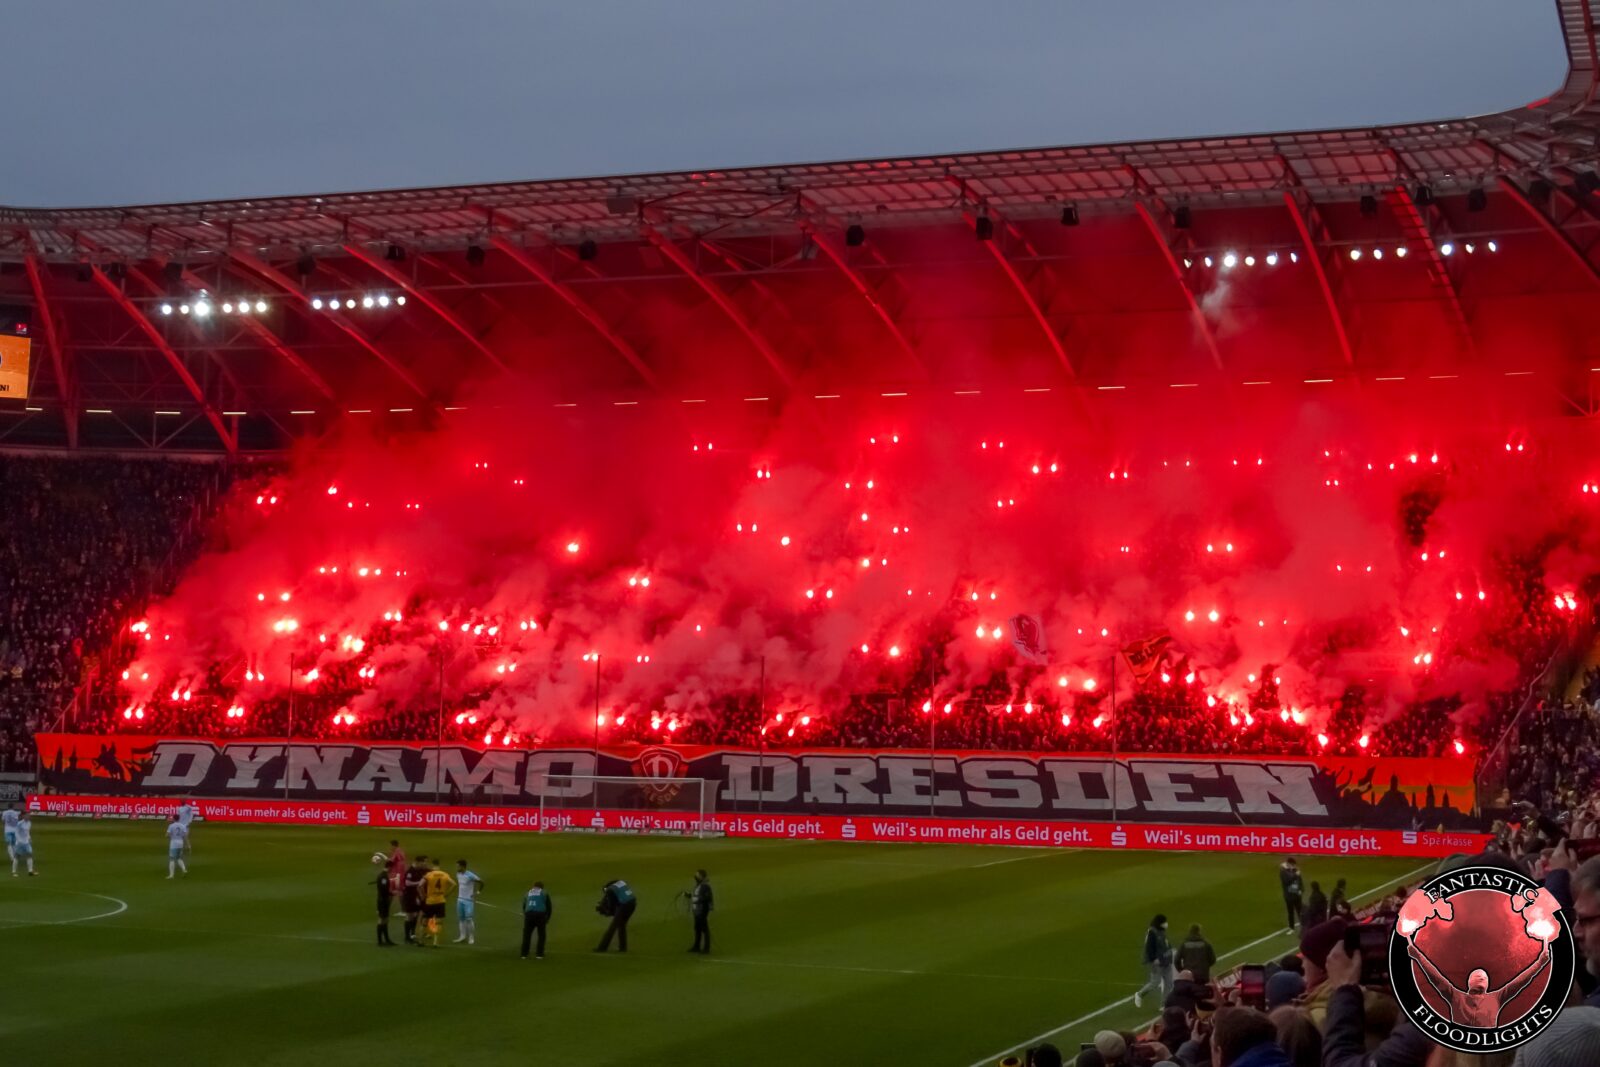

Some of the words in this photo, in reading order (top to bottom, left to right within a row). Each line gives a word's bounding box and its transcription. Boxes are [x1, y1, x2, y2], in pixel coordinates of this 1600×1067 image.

[141, 742, 597, 797] DYNAMO
[721, 755, 1328, 815] DRESDEN
[46, 801, 74, 812] Weil's
[76, 804, 91, 812] um
[93, 802, 116, 813] mehr
[119, 803, 133, 813] als
[134, 803, 155, 814] Geld
[205, 805, 234, 817] Weil's
[237, 809, 252, 818] um
[254, 806, 279, 818] mehr
[282, 807, 296, 819] als
[298, 807, 320, 819] Geld
[322, 808, 348, 822] geht.
[384, 809, 422, 823] Weil's
[426, 813, 446, 823] um
[450, 810, 483, 824] mehr
[486, 811, 504, 825] als
[508, 811, 537, 826] Geld
[541, 813, 575, 830] geht.
[620, 815, 661, 829] Weil's
[664, 819, 686, 831] um
[689, 816, 726, 832] mehr
[729, 819, 749, 832] als
[752, 819, 784, 833] Geld
[788, 820, 825, 837] geht.
[872, 822, 916, 837] Weil's
[920, 826, 944, 838] um
[948, 823, 987, 839] mehr
[990, 825, 1011, 840] als
[1015, 826, 1049, 841] Geld
[1054, 827, 1093, 845] geht.
[1144, 830, 1191, 845] Weil's
[1196, 834, 1222, 846] um
[1225, 831, 1267, 847] mehr
[1271, 832, 1294, 848] als
[1298, 832, 1335, 849] Geld
[1339, 834, 1382, 853] geht.
[1422, 834, 1473, 847] Sparkasse
[435, 878, 441, 890] 4
